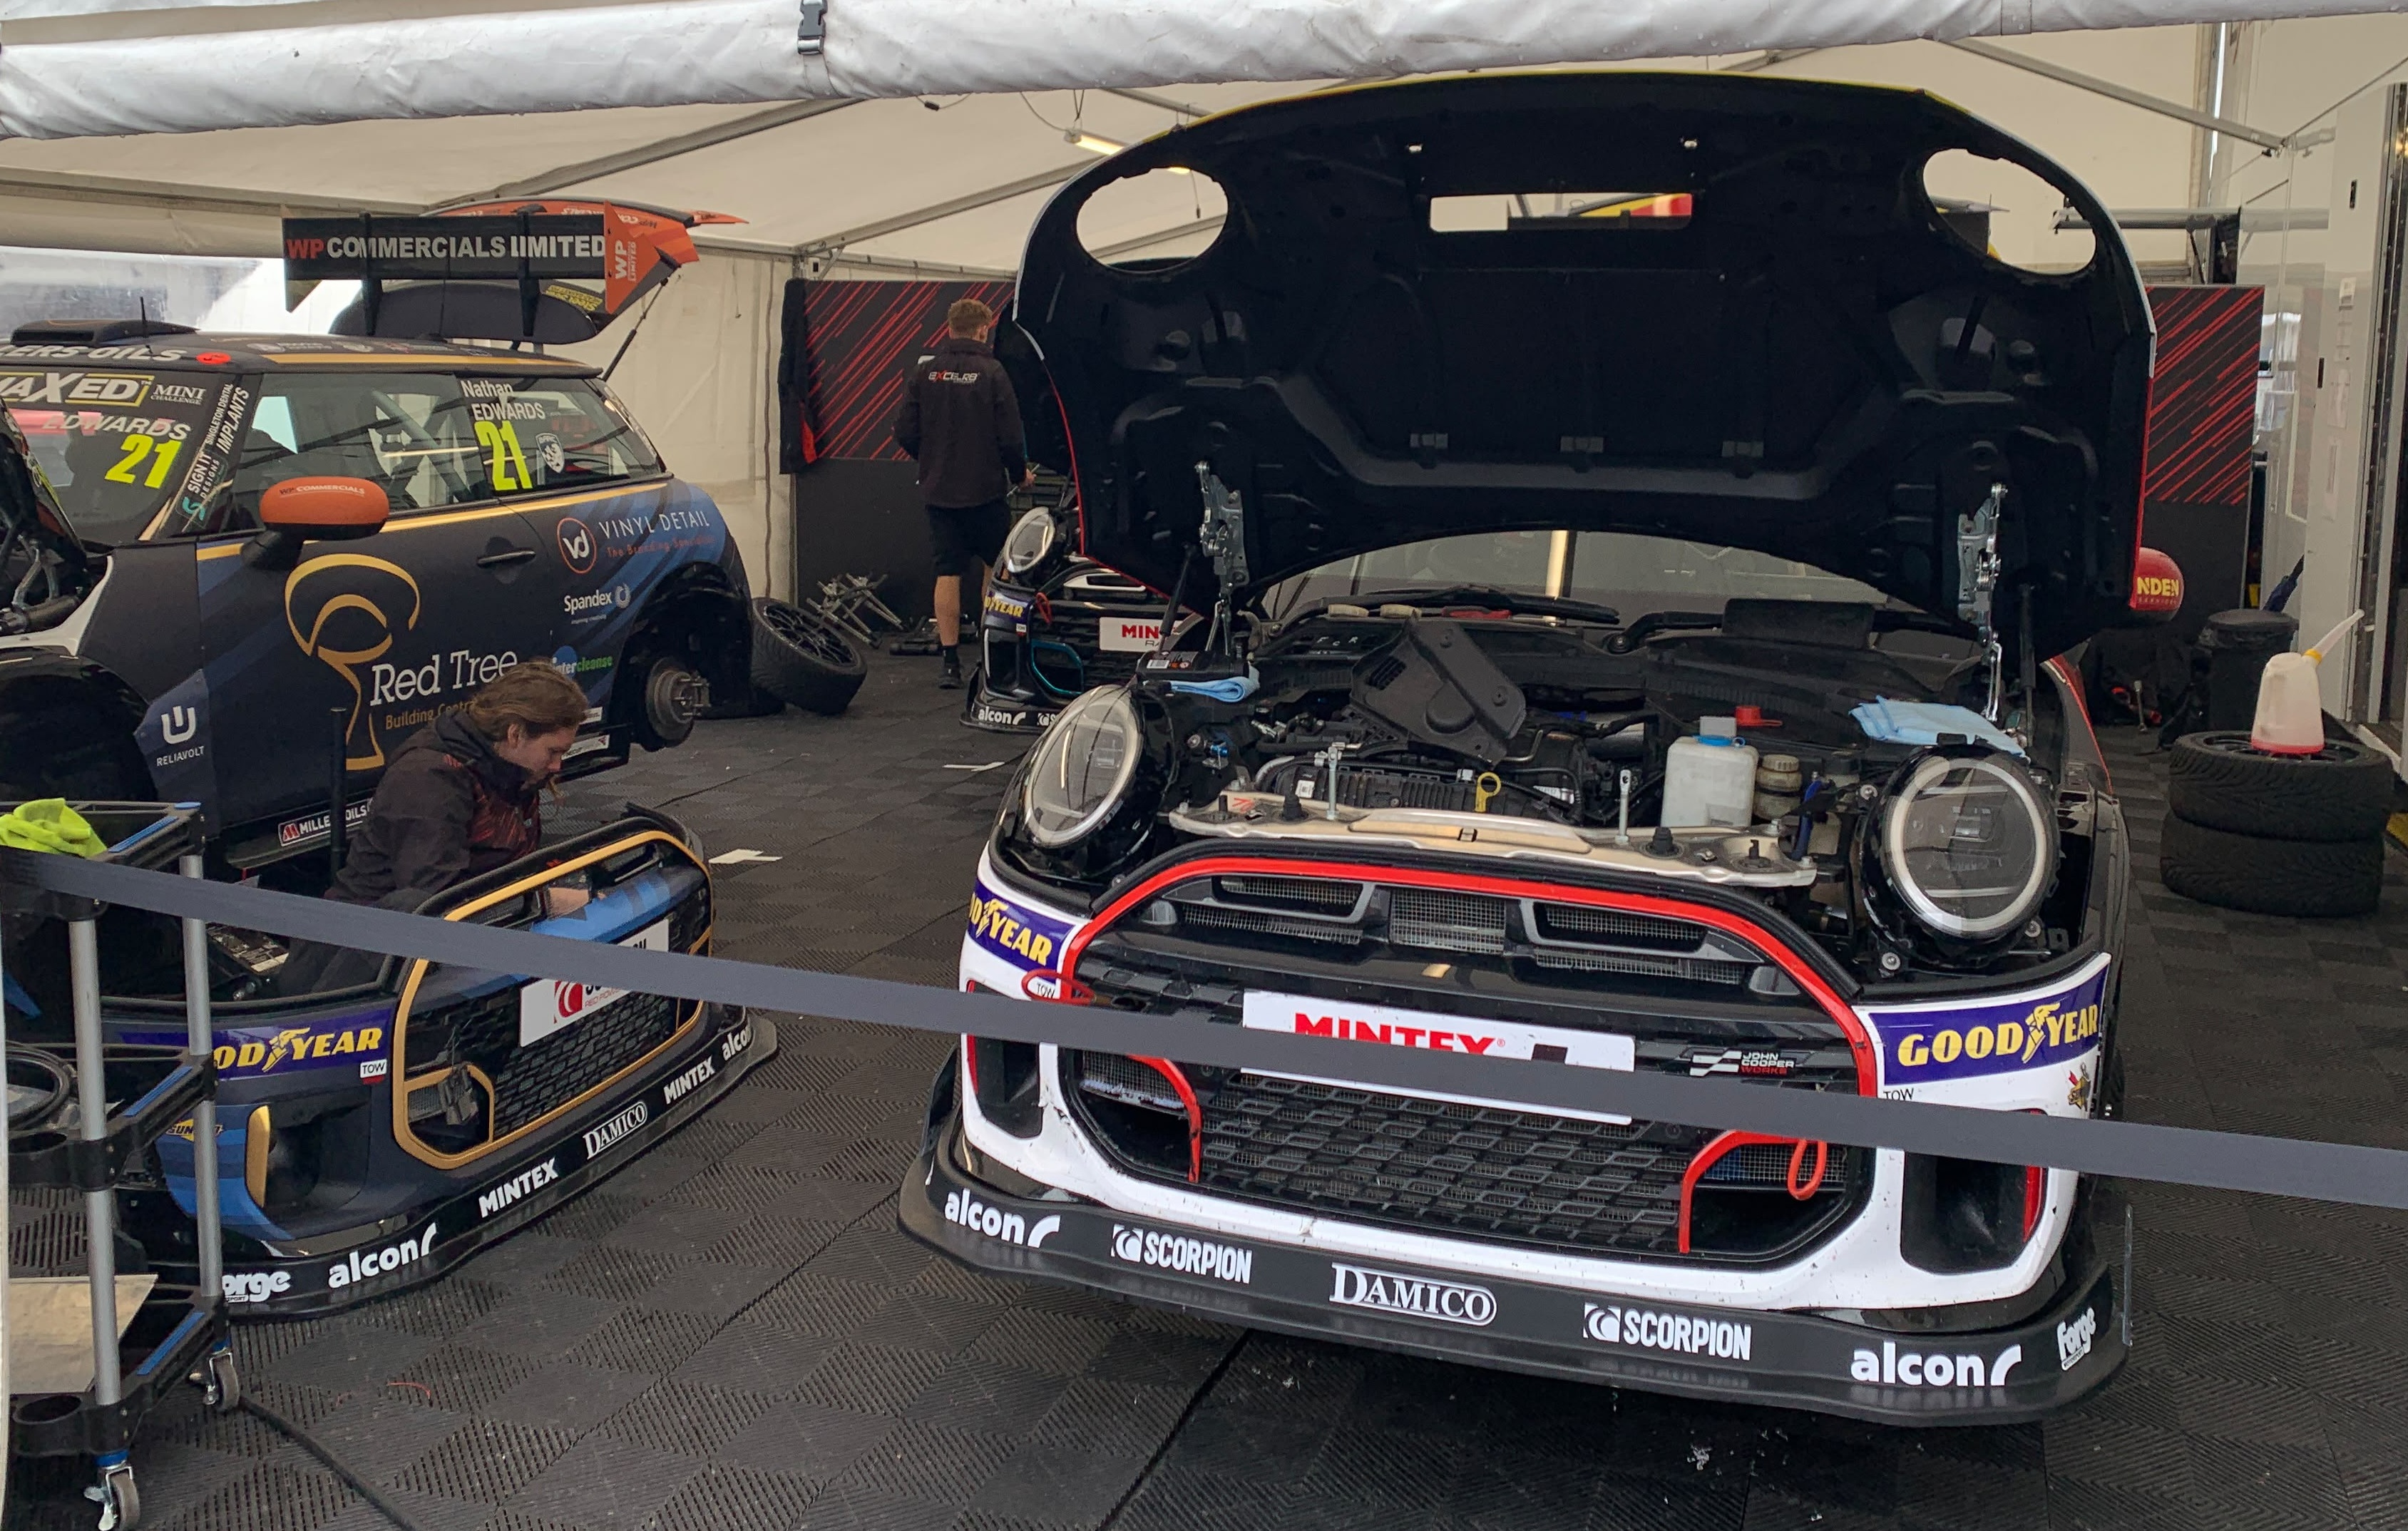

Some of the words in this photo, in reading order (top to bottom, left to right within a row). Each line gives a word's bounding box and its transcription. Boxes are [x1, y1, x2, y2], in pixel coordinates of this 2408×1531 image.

[286, 238, 324, 260] WP
[327, 236, 506, 258] COMMERCIALS
[511, 235, 605, 257] LIMITED
[615, 240, 627, 279] WP
[88, 347, 187, 362] OILS
[150, 394, 203, 406] CHALLENGE
[153, 384, 206, 400] MINI
[461, 380, 513, 398] Nathan
[205, 407, 225, 445] SINGLETON
[218, 383, 234, 407] DENTAL
[216, 386, 249, 454] IMPLANTS
[472, 402, 545, 421] EDWARDS
[42, 414, 191, 440] EDWARDS
[104, 434, 182, 488] 21
[474, 420, 533, 491] 21
[188, 461, 206, 493] SIGN
[198, 451, 212, 464] IT
[200, 459, 220, 499] DESIGNS
[297, 484, 365, 495] COMMERCIALS
[599, 515, 655, 539] VINYL
[659, 510, 710, 532] DETAIL
[564, 589, 613, 615] Spandex
[1122, 625, 1159, 639] MIN
[370, 654, 441, 706] Red
[450, 650, 518, 690] Tree
[553, 656, 613, 675] ntercleanse
[386, 708, 434, 730] Building
[978, 706, 1012, 724] alcon
[157, 746, 205, 767] RELIAVOLT
[299, 815, 331, 834] MILLE
[1037, 983, 1056, 999] TOW
[213, 1028, 382, 1070] ODYEAR
[1742, 1052, 1779, 1061] JOHN
[362, 1062, 386, 1075] TOW
[1741, 1060, 1795, 1068] COOPER
[1741, 1066, 1788, 1075] WORKS
[663, 1055, 715, 1105] MINTEX
[1883, 1087, 1914, 1100] TOW
[583, 1102, 646, 1160] DAMICO
[478, 1157, 559, 1218] MINTEX
[944, 1188, 1025, 1245] alcon
[328, 1239, 419, 1289] alcon
[1144, 1230, 1253, 1284] SCORPION
[222, 1271, 291, 1303] orge
[1330, 1262, 1492, 1321] DAMICO
[1624, 1307, 1751, 1361] SCORPION
[1851, 1341, 1985, 1387] alcon
